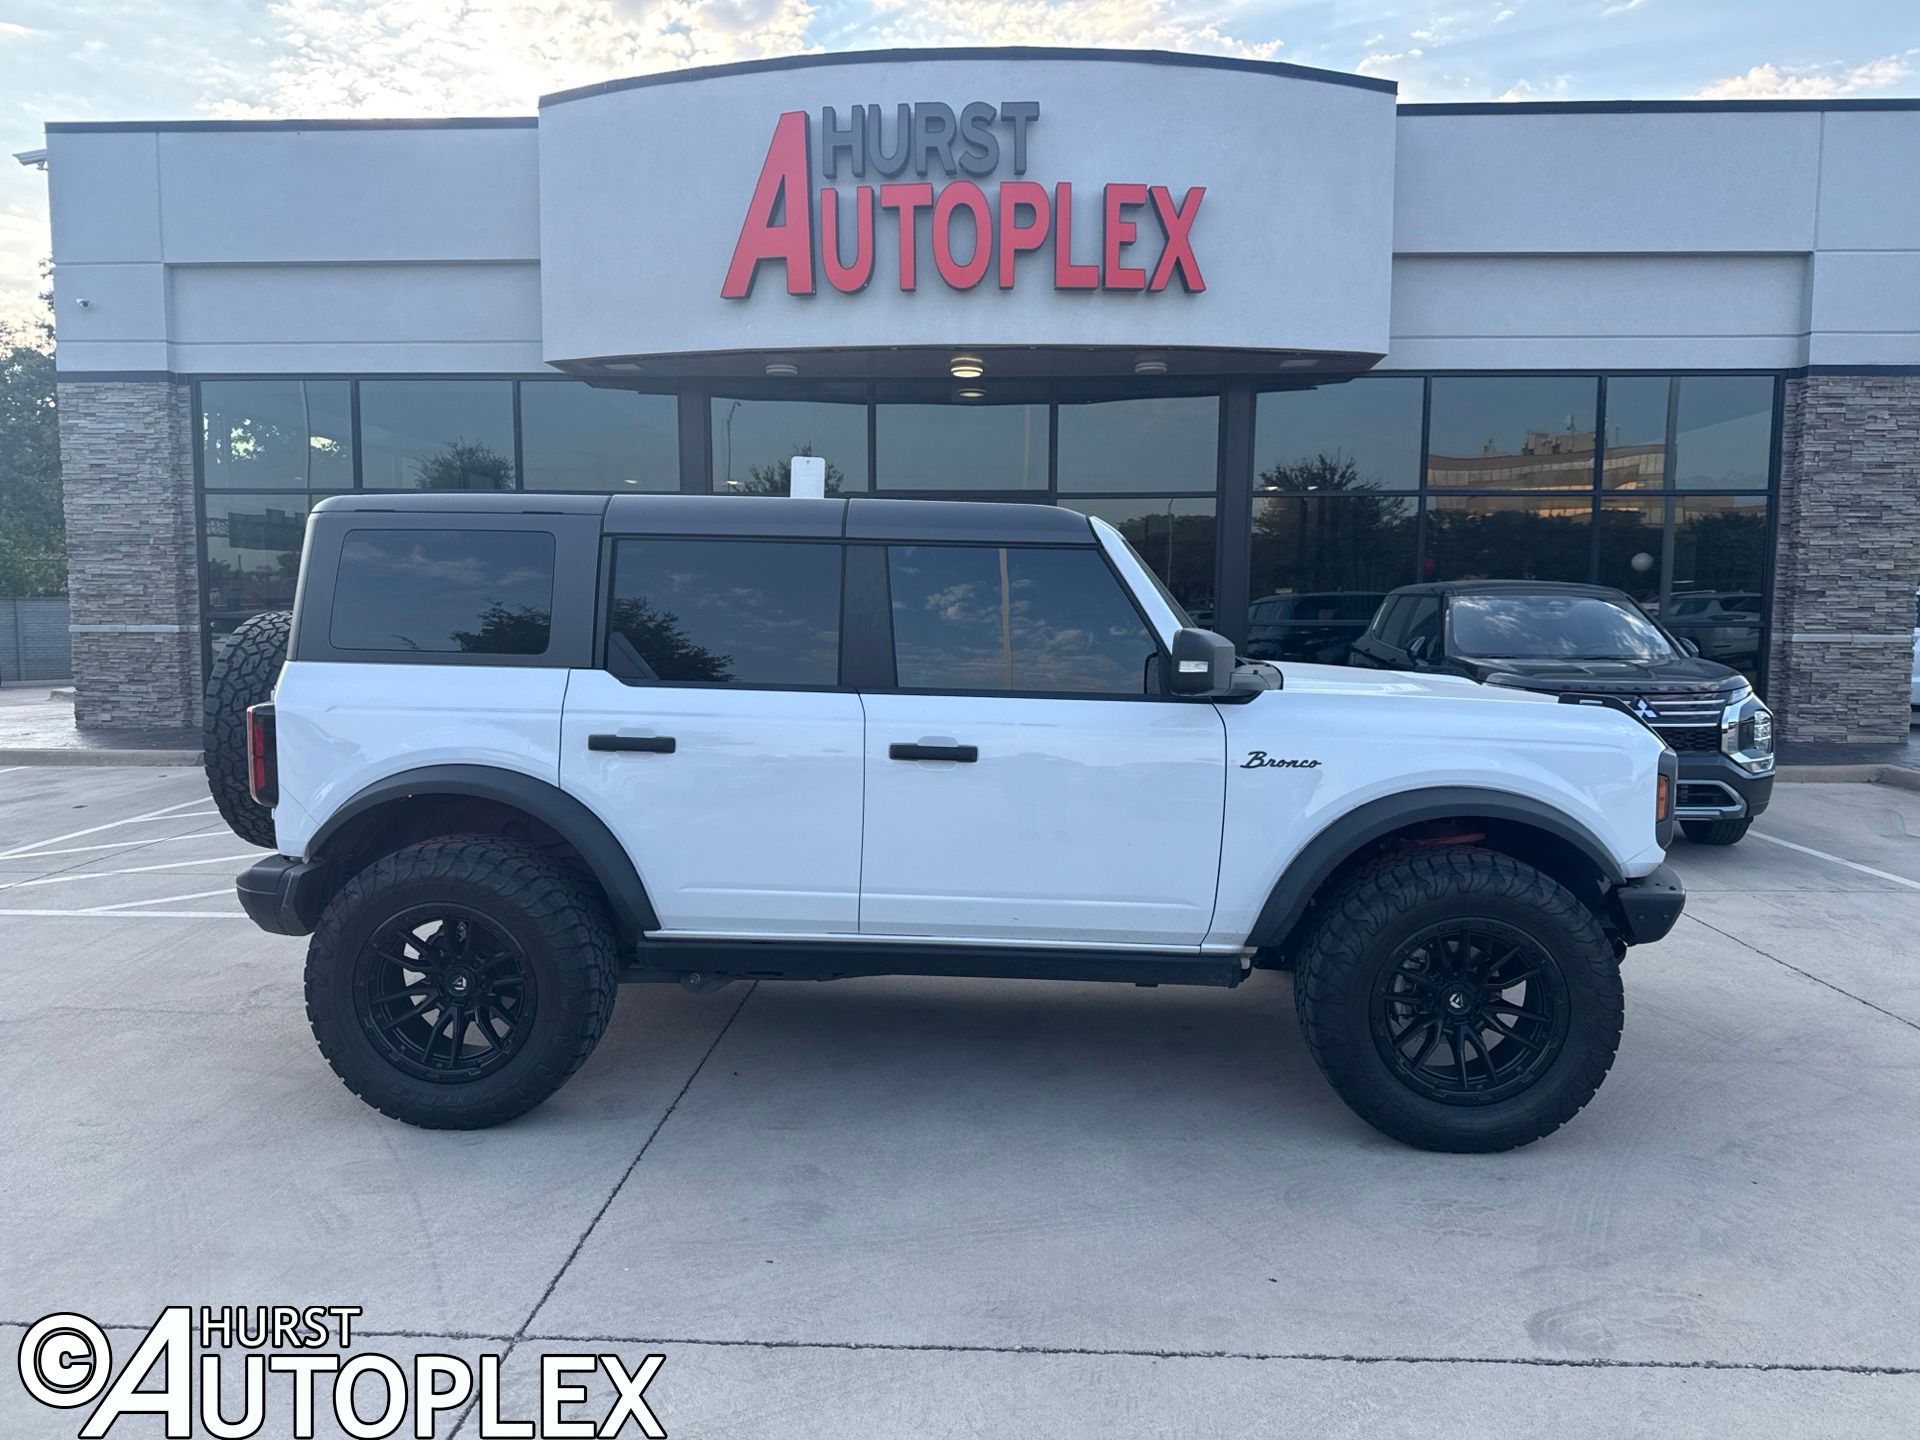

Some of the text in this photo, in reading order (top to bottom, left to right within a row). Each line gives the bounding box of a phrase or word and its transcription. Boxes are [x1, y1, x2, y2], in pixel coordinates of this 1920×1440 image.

[823, 101, 1040, 178] HURST
[720, 111, 1206, 299] AUTOPLEX
[1240, 750, 1322, 769] Bronco
